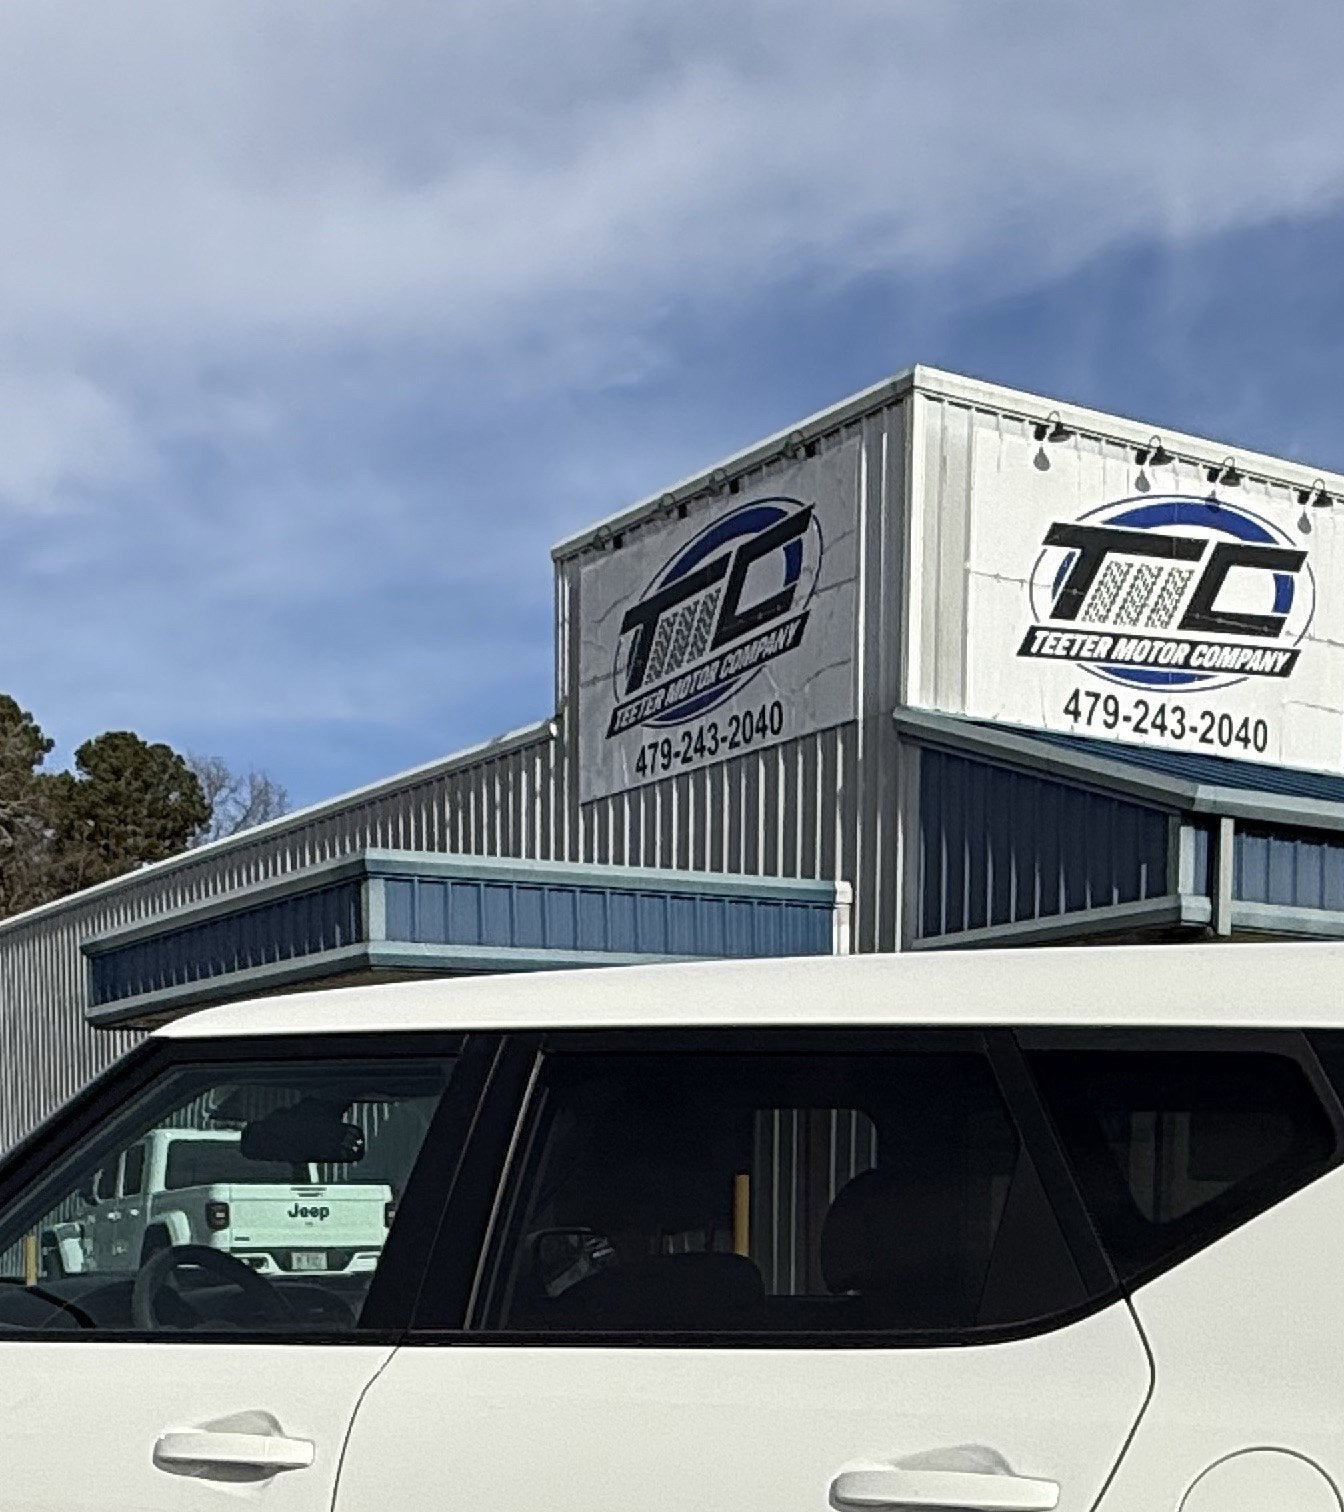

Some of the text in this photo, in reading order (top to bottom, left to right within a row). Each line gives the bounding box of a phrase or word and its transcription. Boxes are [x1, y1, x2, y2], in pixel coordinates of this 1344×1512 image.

[618, 620, 799, 728] TEETER MOTOR COMPANY
[1030, 630, 1291, 673] TEETER MOTOR COMPANY
[636, 700, 784, 778] 479-243-2040
[1063, 688, 1269, 754] 479-243-2040
[287, 1202, 330, 1221] Jeep
